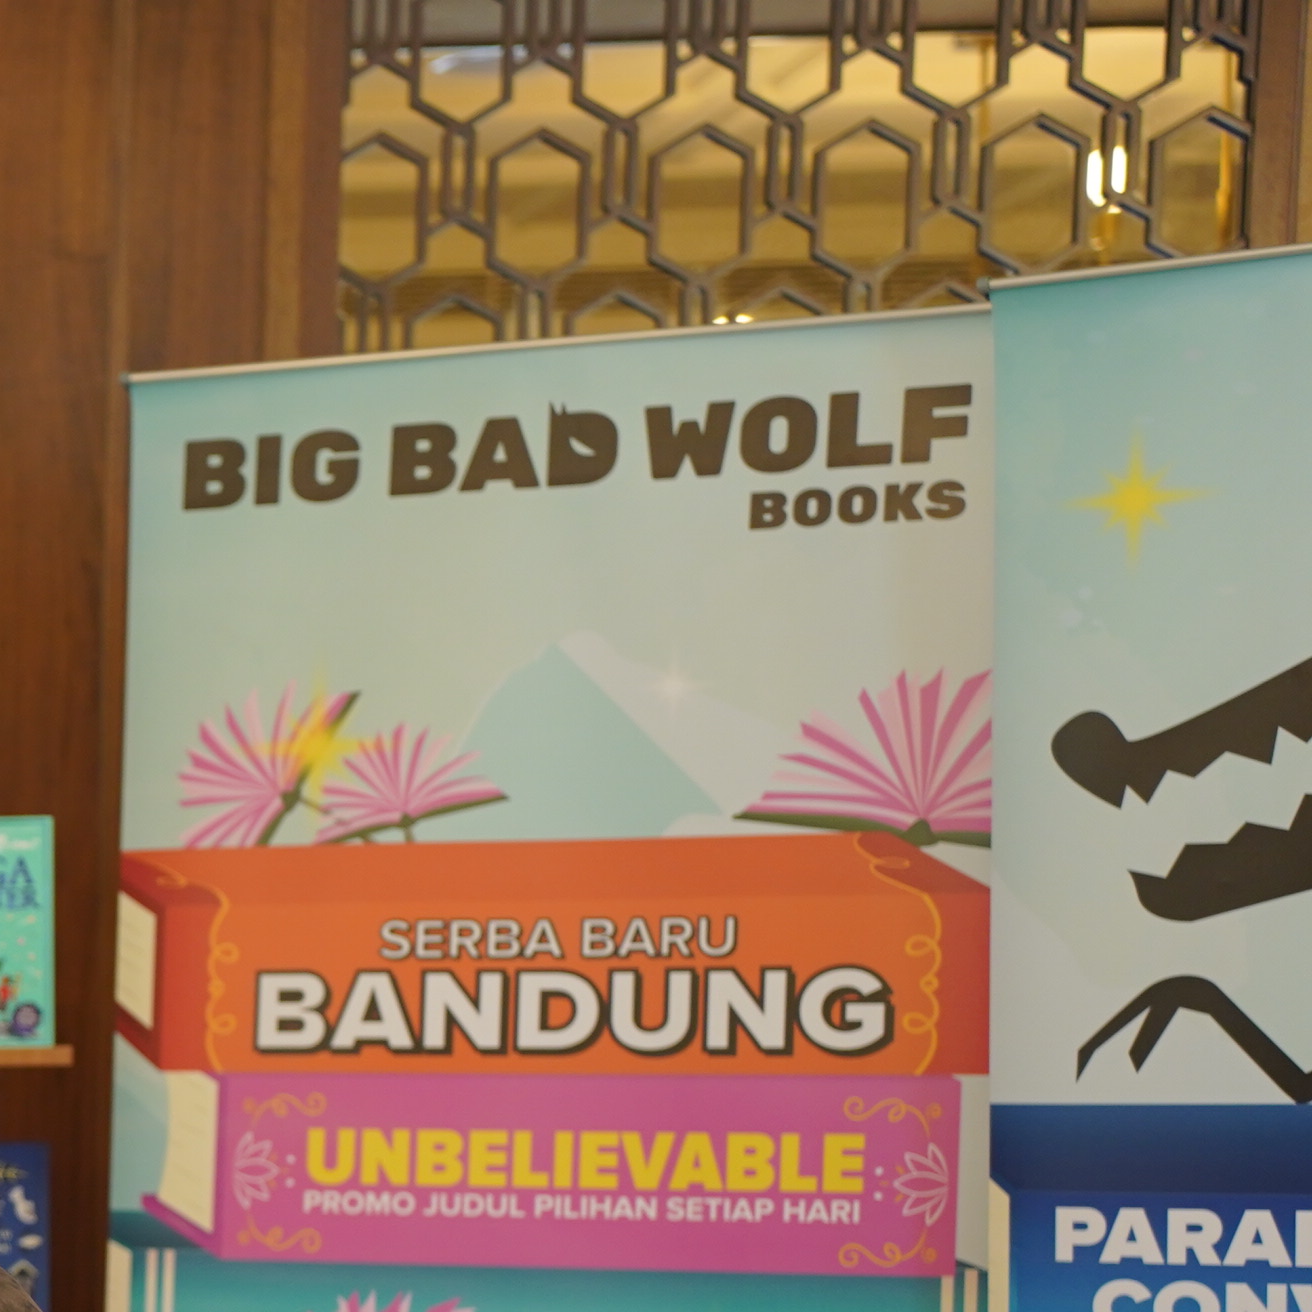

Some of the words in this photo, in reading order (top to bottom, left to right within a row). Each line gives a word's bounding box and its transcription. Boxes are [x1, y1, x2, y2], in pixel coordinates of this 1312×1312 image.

[182, 429, 361, 511] BIG
[387, 402, 619, 497] BAD
[645, 384, 973, 480] WOLF
[748, 479, 968, 531] BOOKS
[380, 917, 564, 960] SERBA
[580, 914, 737, 958] BARU
[252, 965, 896, 1056] BANDUNG
[304, 1126, 867, 1194] UNBELIEVABLE
[302, 1188, 414, 1219] PROMO
[423, 1191, 527, 1221] JUDUL
[533, 1193, 658, 1223] PILIHAN
[665, 1196, 775, 1225] SETIAP
[782, 1198, 861, 1226] HARI
